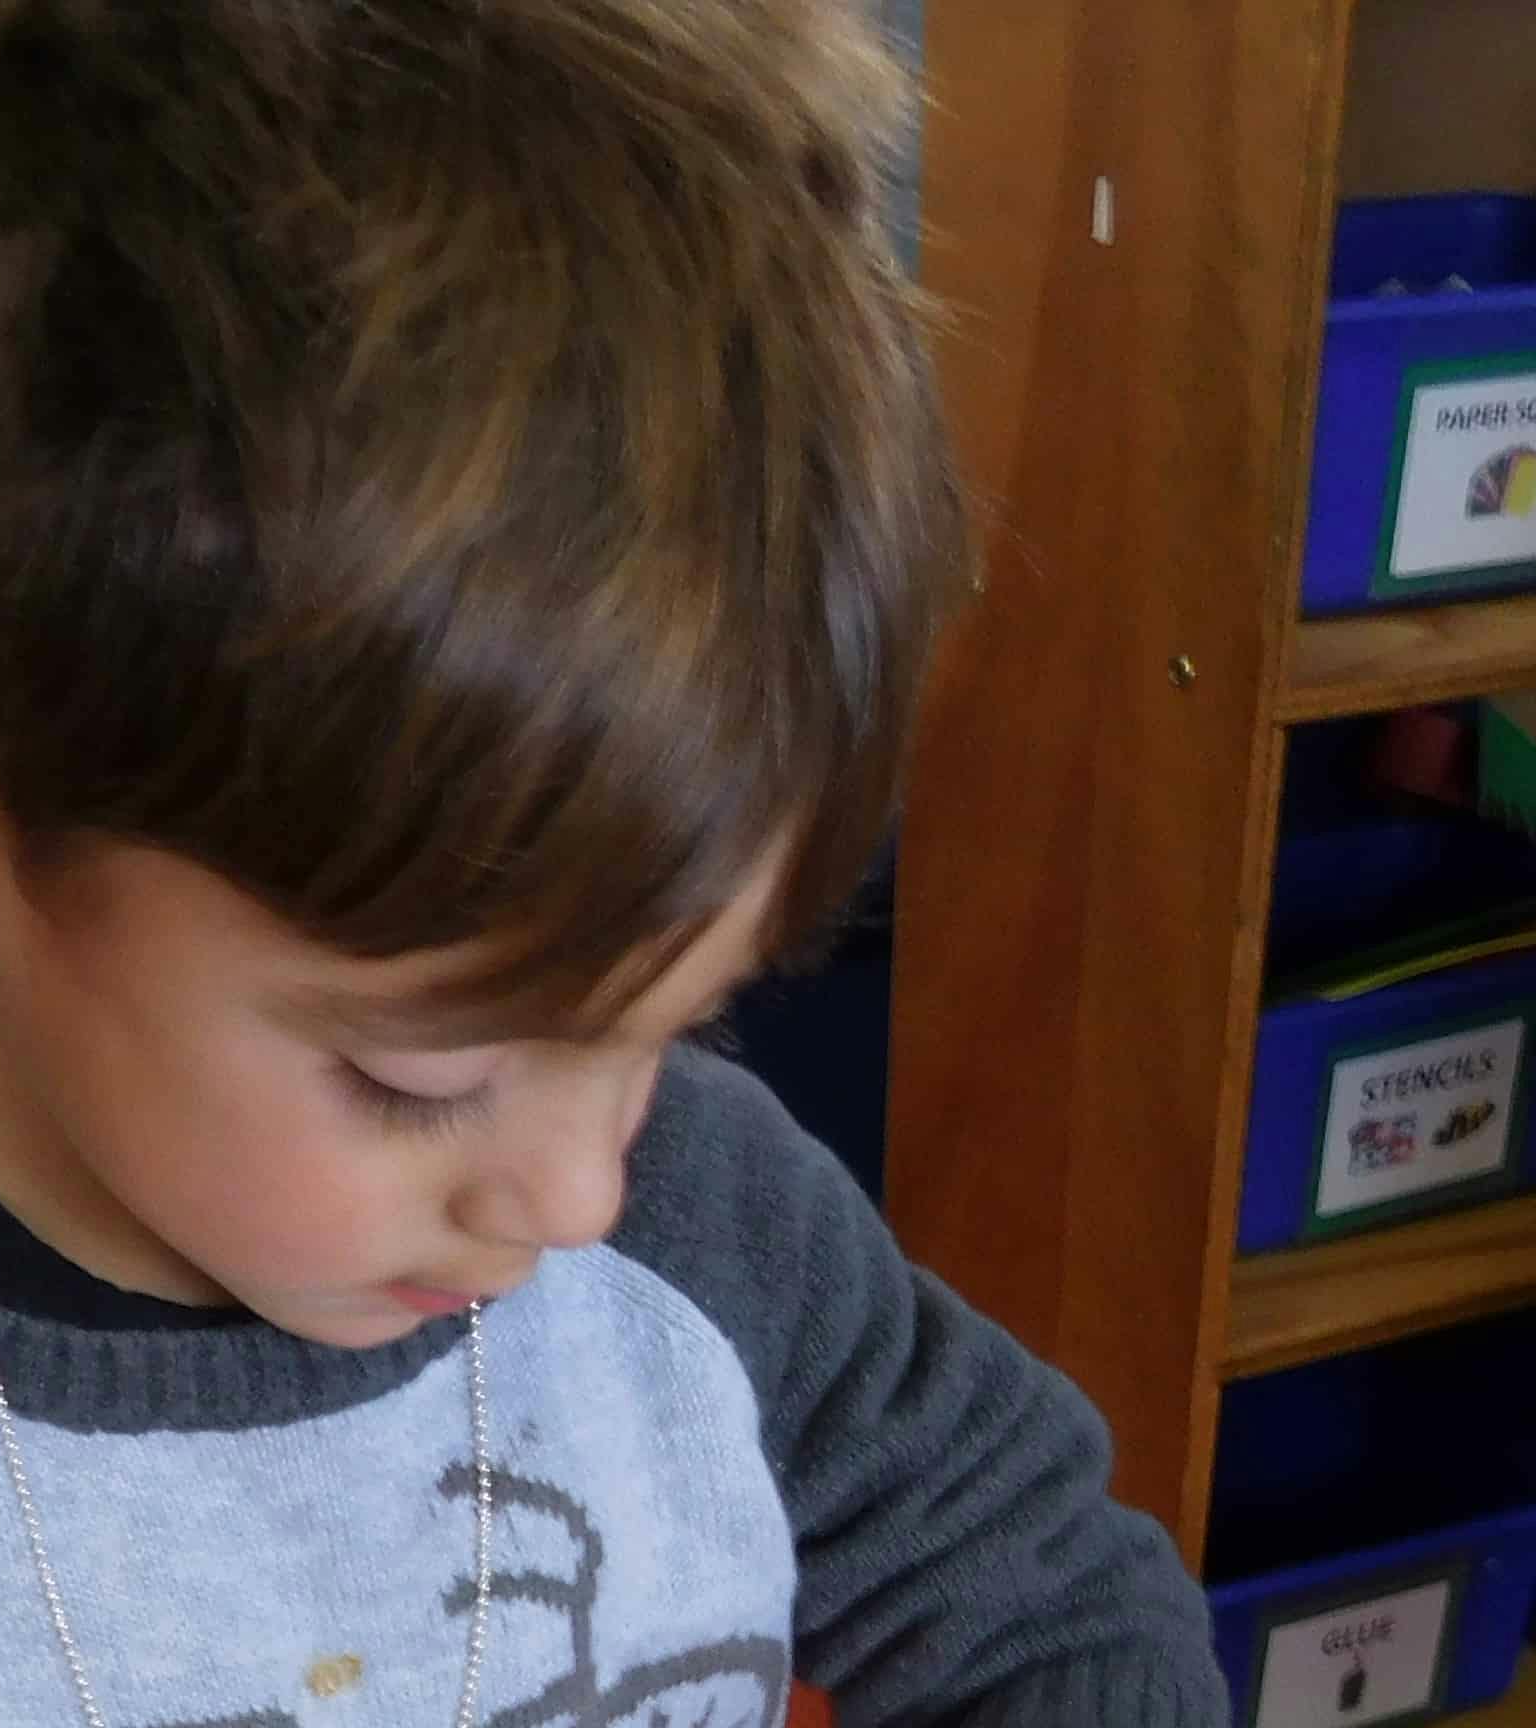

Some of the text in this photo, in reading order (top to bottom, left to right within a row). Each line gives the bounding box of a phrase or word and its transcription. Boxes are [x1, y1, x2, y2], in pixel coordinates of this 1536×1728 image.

[1435, 402, 1510, 434] PAPER
[1361, 1048, 1497, 1109] STENCILS
[1320, 1615, 1397, 1657] GLUE
